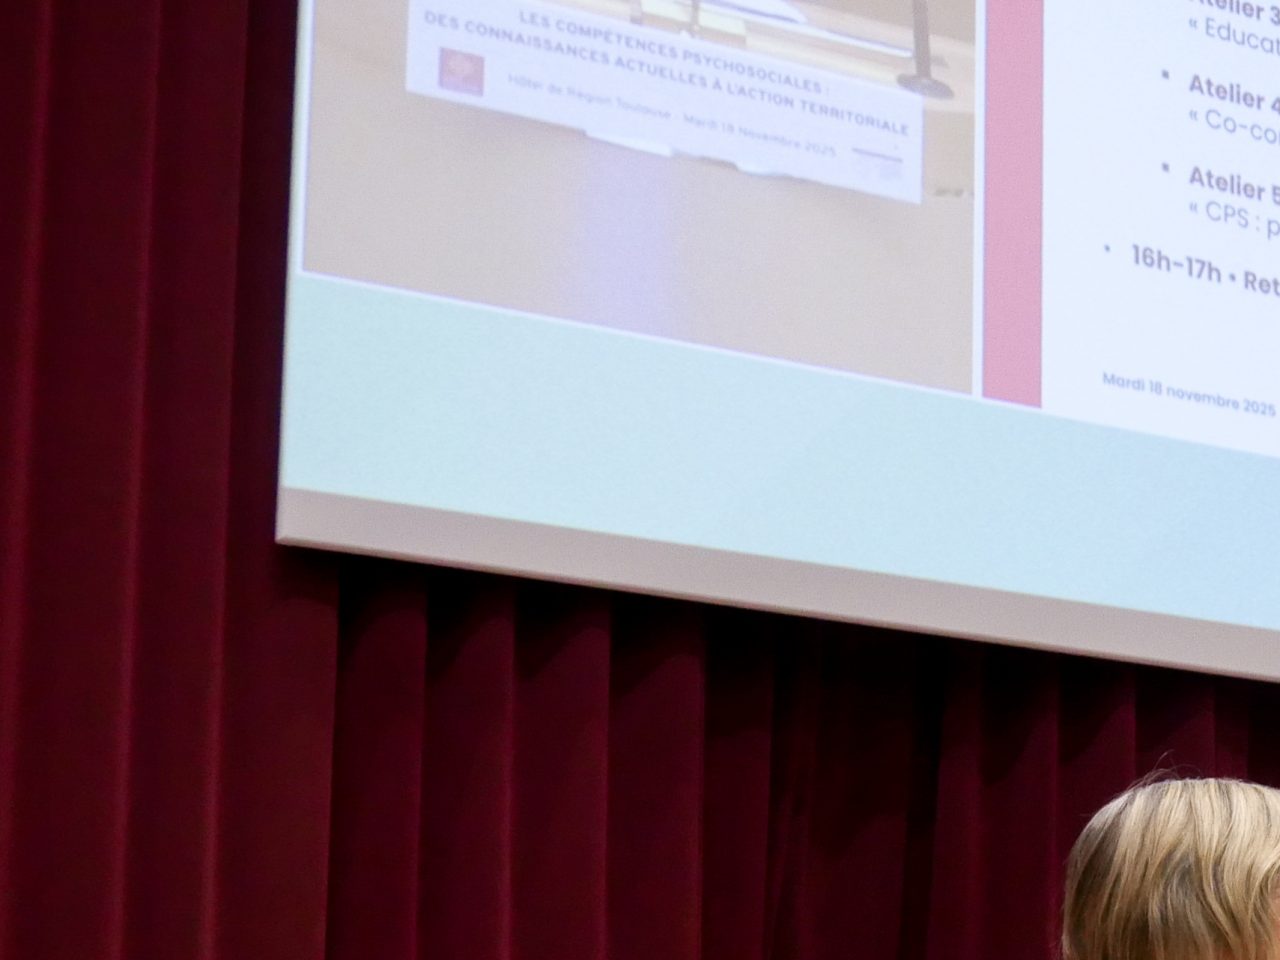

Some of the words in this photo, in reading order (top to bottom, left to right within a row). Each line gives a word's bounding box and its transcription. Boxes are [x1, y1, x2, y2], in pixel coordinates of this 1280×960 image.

[519, 10, 550, 28] LES
[555, 19, 678, 59] COMPÉTENCES
[682, 49, 822, 94] PSYCHOSOCIALES
[424, 10, 459, 30] DES
[464, 20, 610, 65] CONNAISSANCES
[614, 56, 707, 88] ACTUELLES
[712, 77, 722, 91] À
[726, 82, 794, 108] L'ACTION
[800, 99, 908, 136] TERRITORIALE
[1188, 74, 1265, 110] Atelier
[1189, 166, 1266, 201] Atelier
[1205, 200, 1249, 229] CPS
[1102, 372, 1145, 391] Mardi
[1149, 380, 1162, 395] 18
[1166, 386, 1240, 410] novembre
[1243, 399, 1276, 417] 2025
